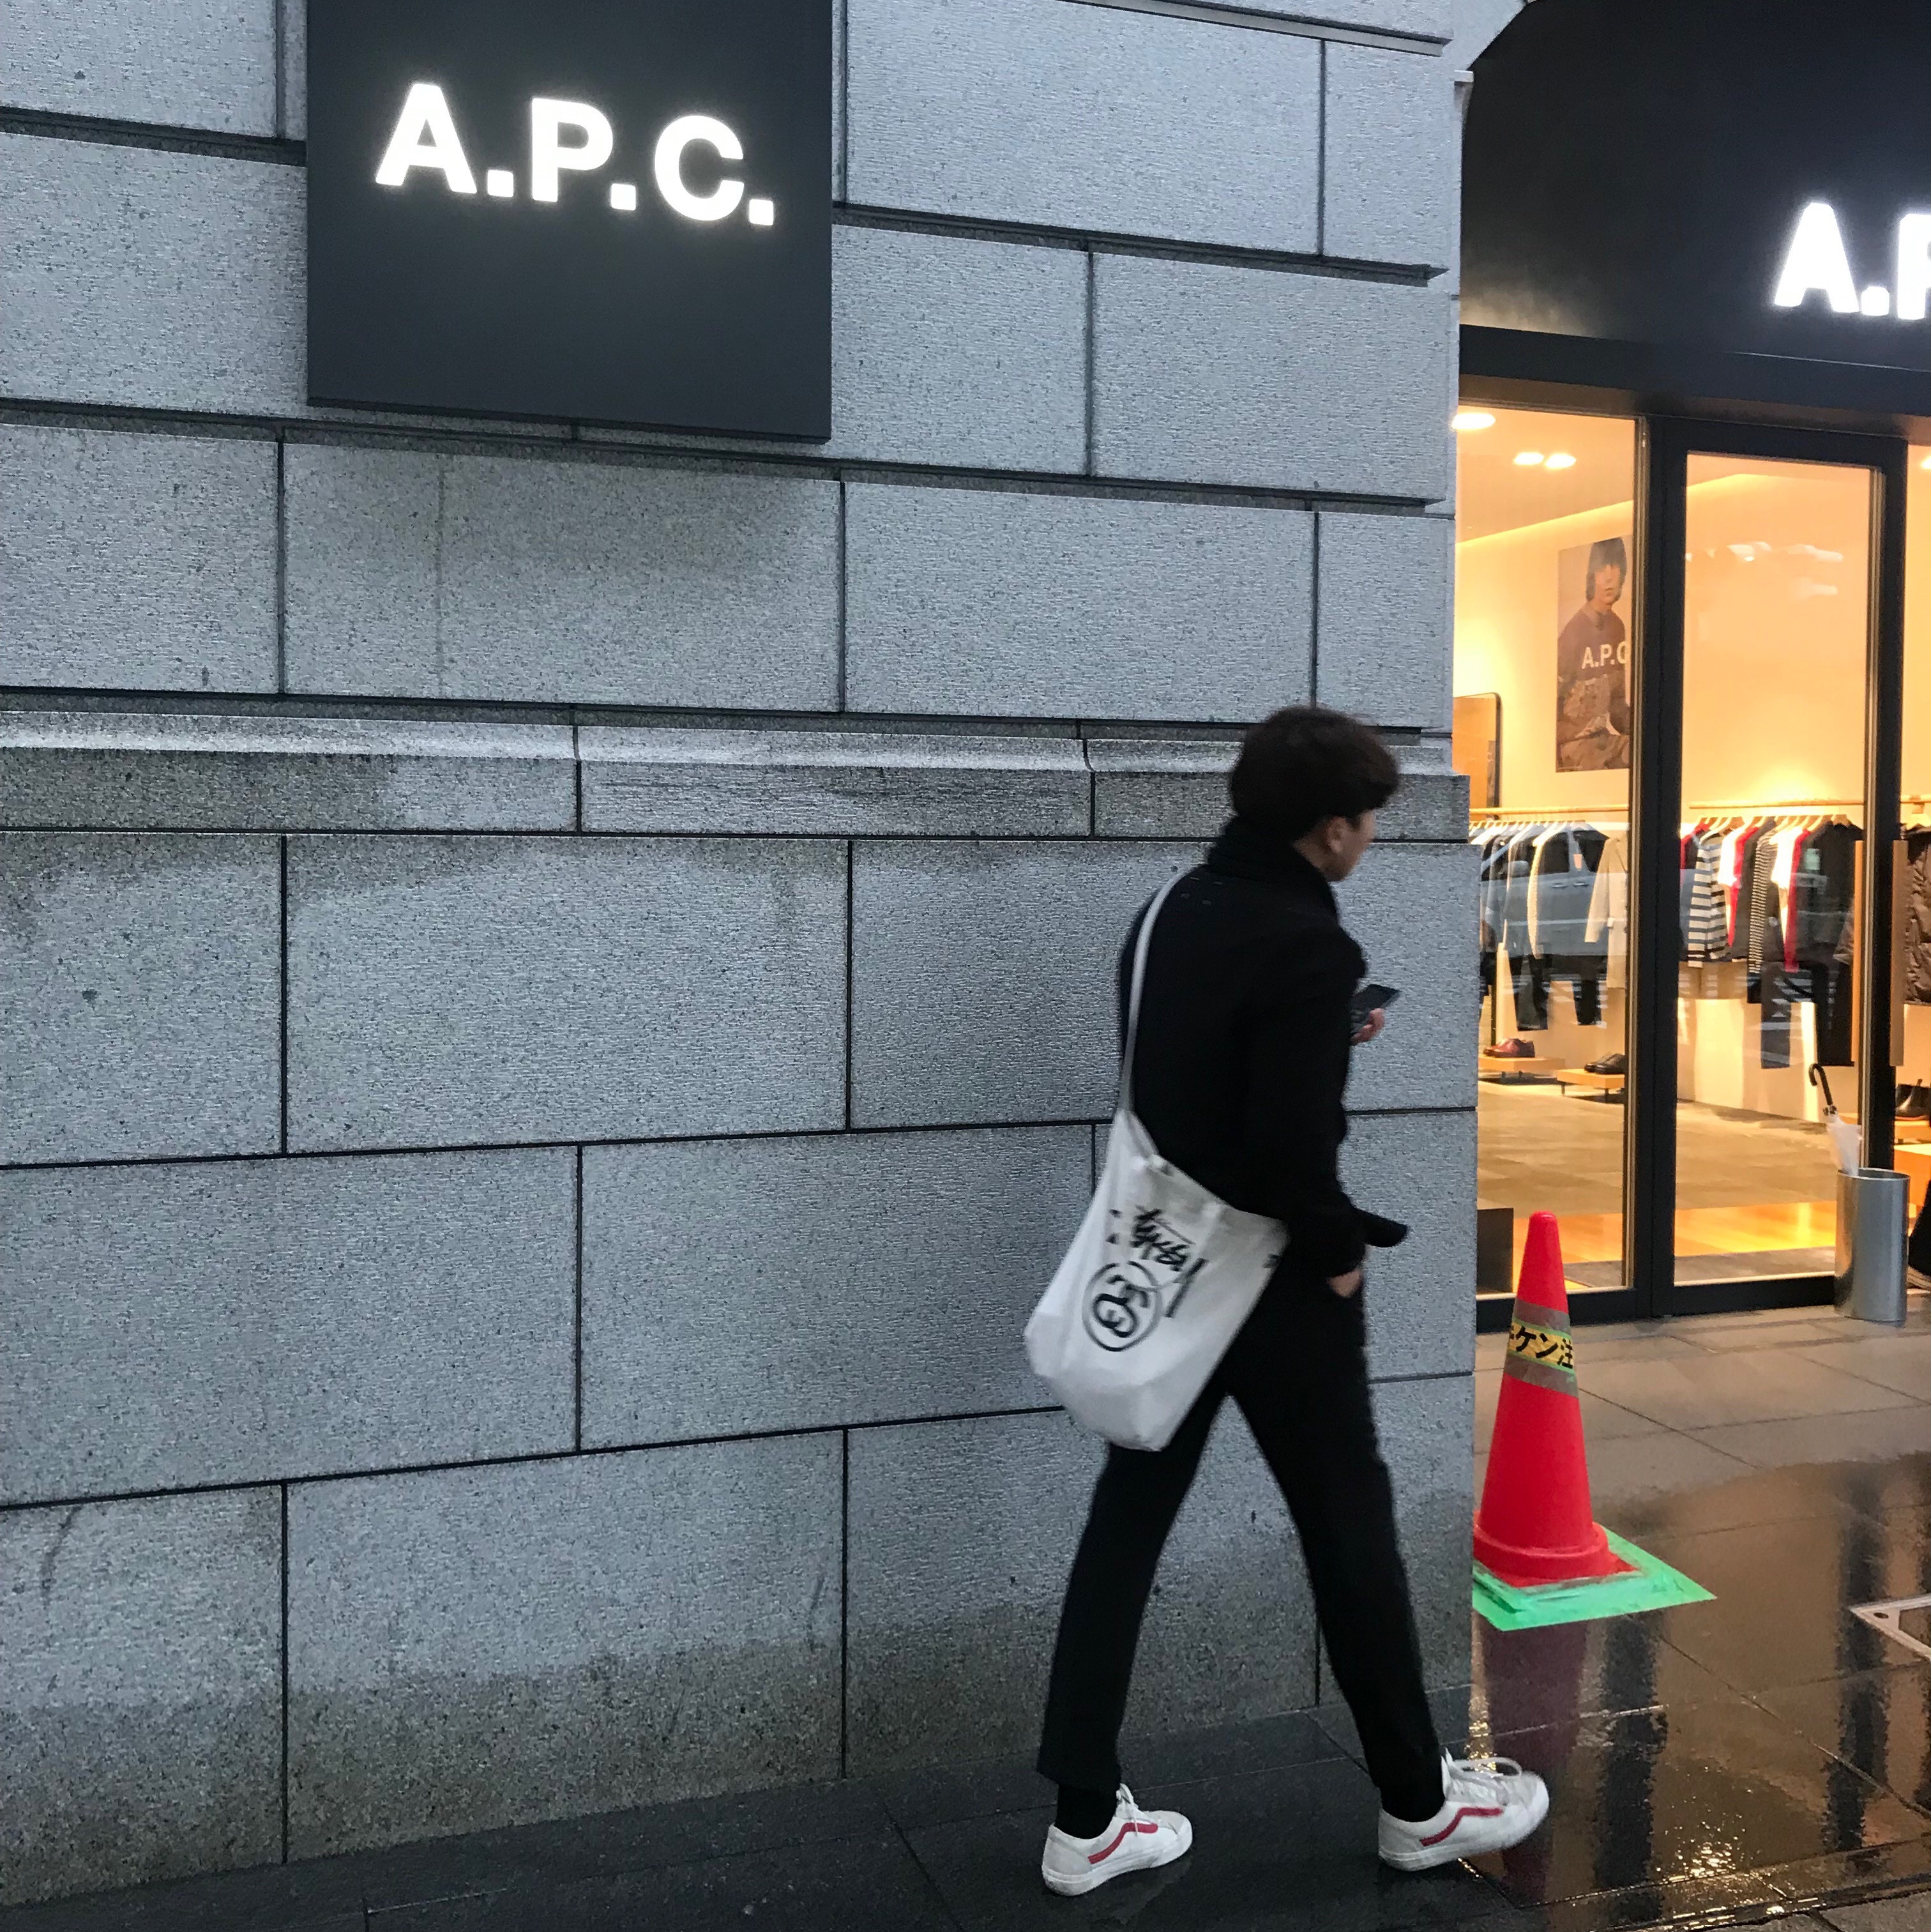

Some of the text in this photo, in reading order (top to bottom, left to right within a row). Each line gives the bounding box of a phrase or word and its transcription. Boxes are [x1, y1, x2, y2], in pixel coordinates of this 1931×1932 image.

[375, 83, 775, 226] A.P.C.
[1510, 1325, 1573, 1369] ケン注
